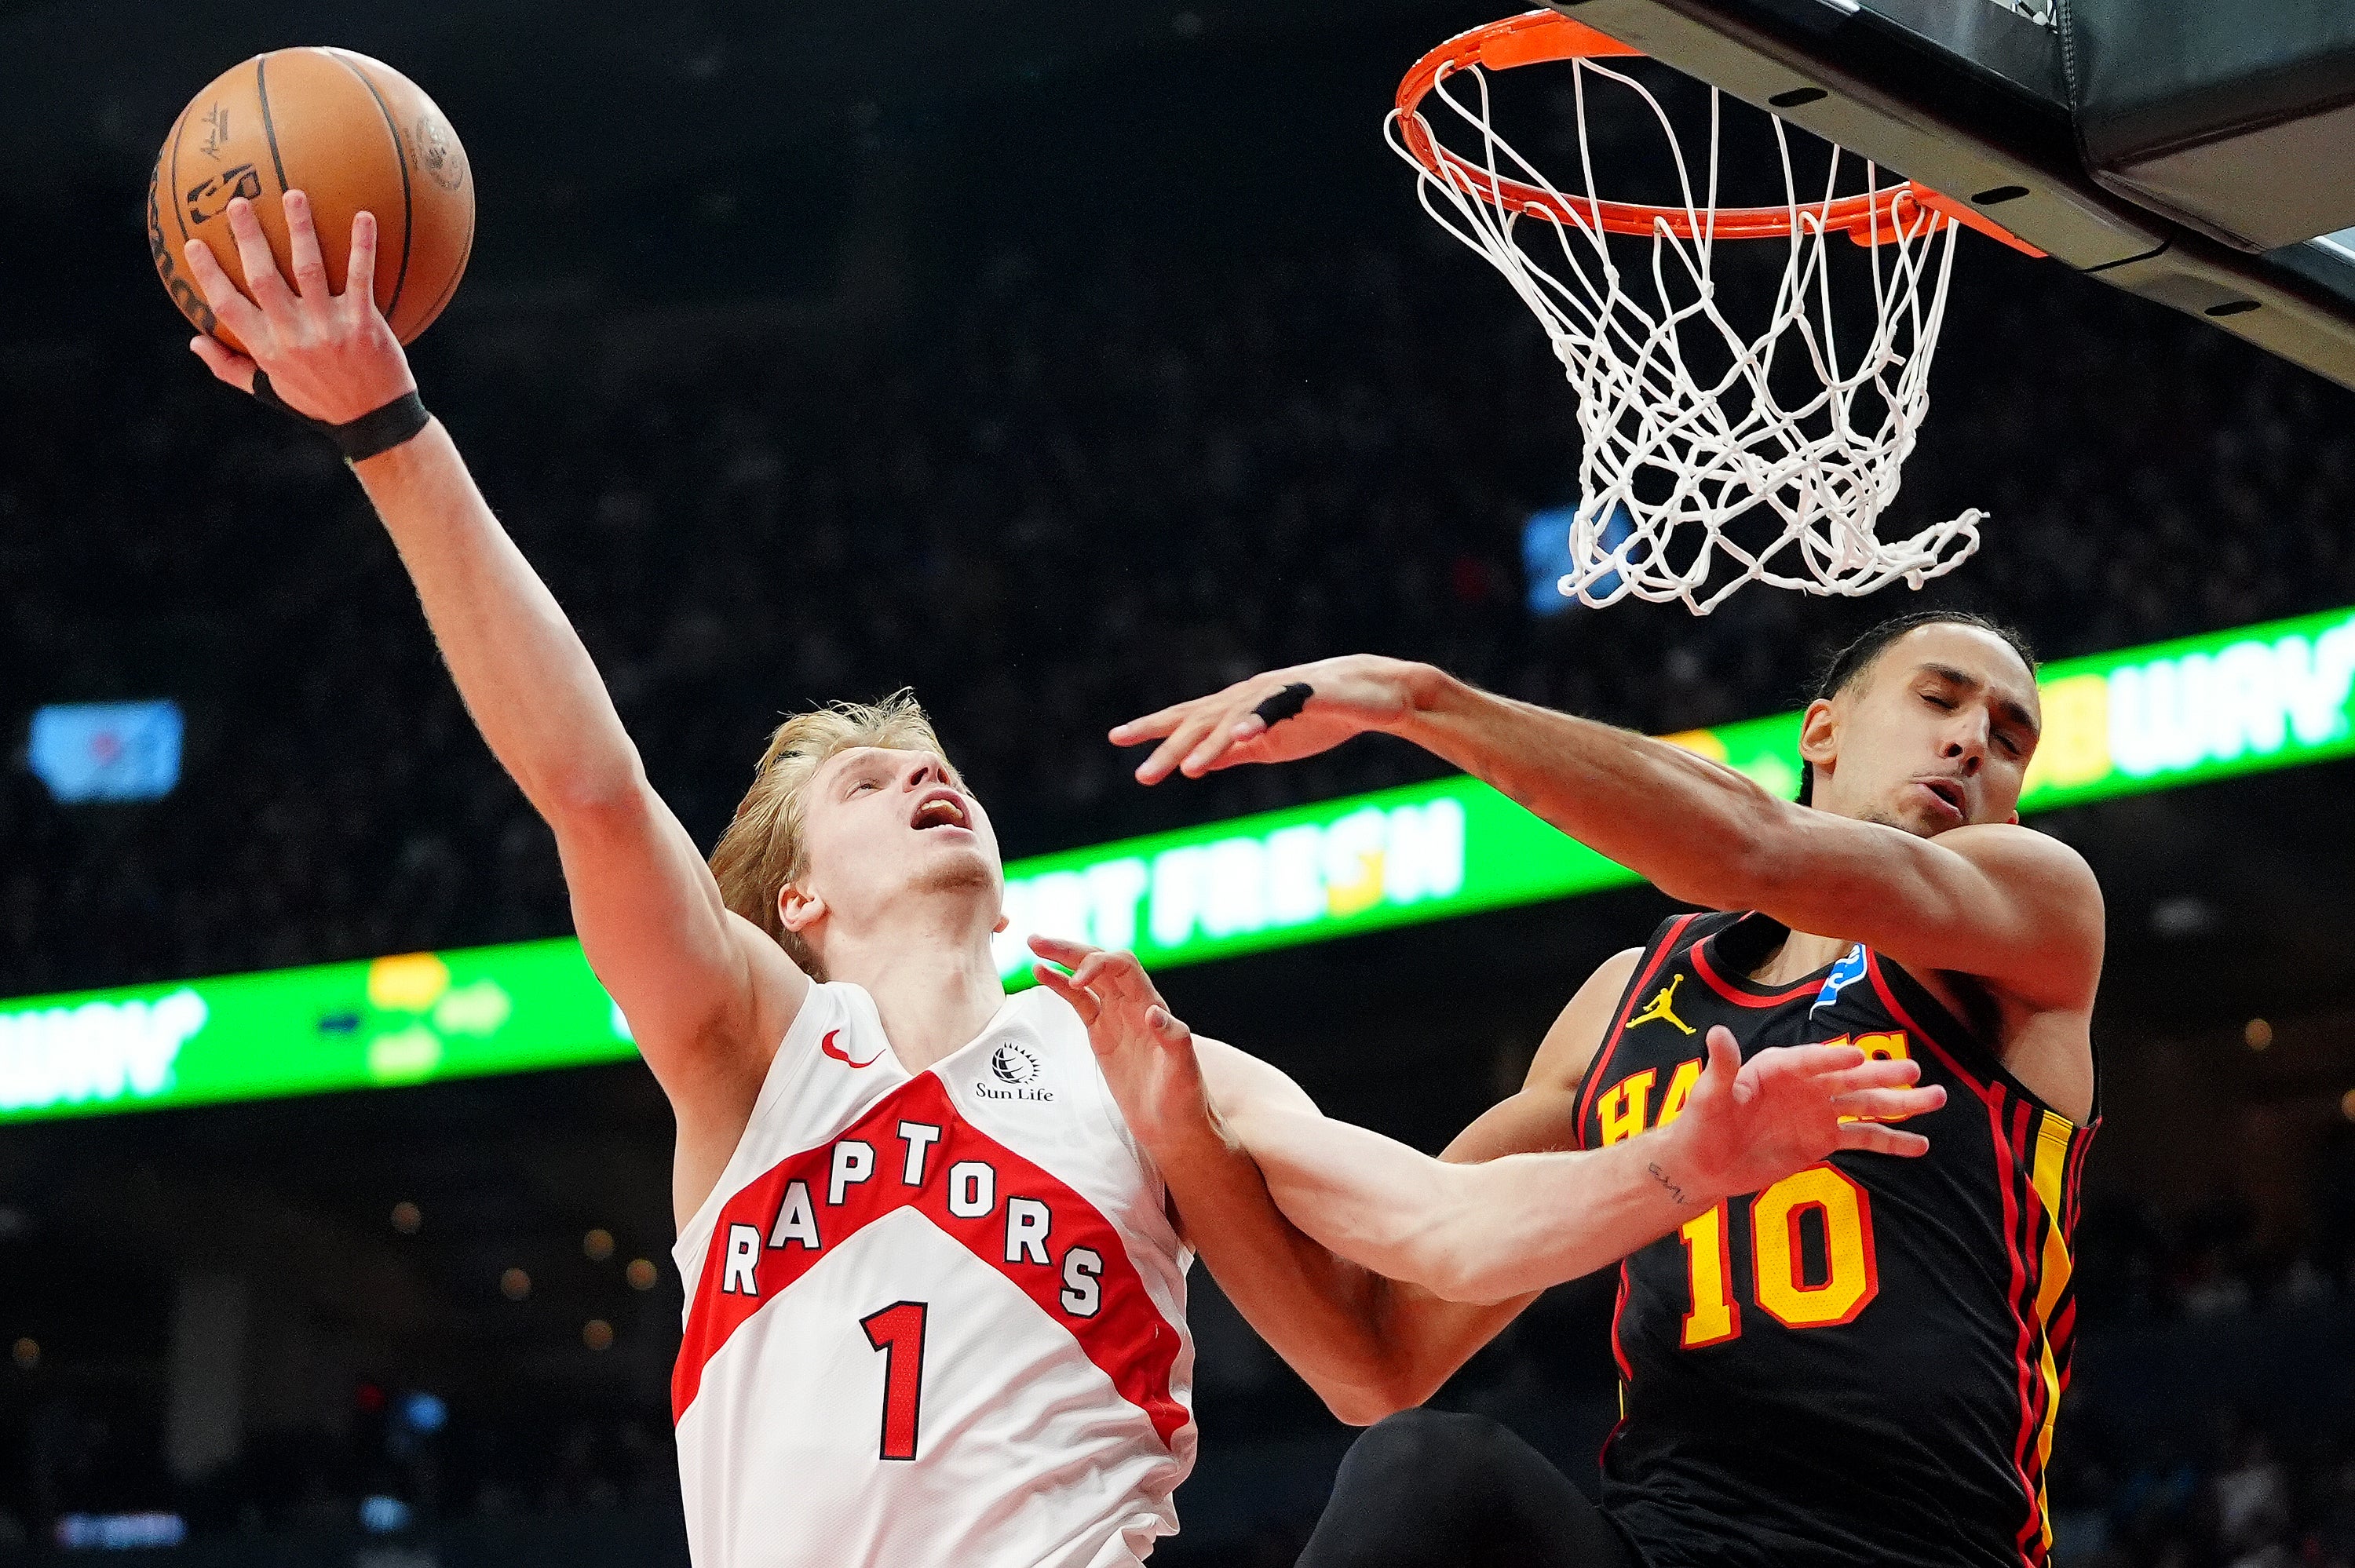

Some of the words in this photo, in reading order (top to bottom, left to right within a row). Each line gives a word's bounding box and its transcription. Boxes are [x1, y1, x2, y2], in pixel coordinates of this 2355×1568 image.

[976, 1082, 1013, 1098] Sun
[1017, 1088, 1054, 1102] Life
[721, 1120, 1104, 1319] RAPTORS
[1680, 1159, 1879, 1350] 10
[858, 1300, 928, 1461] 1
